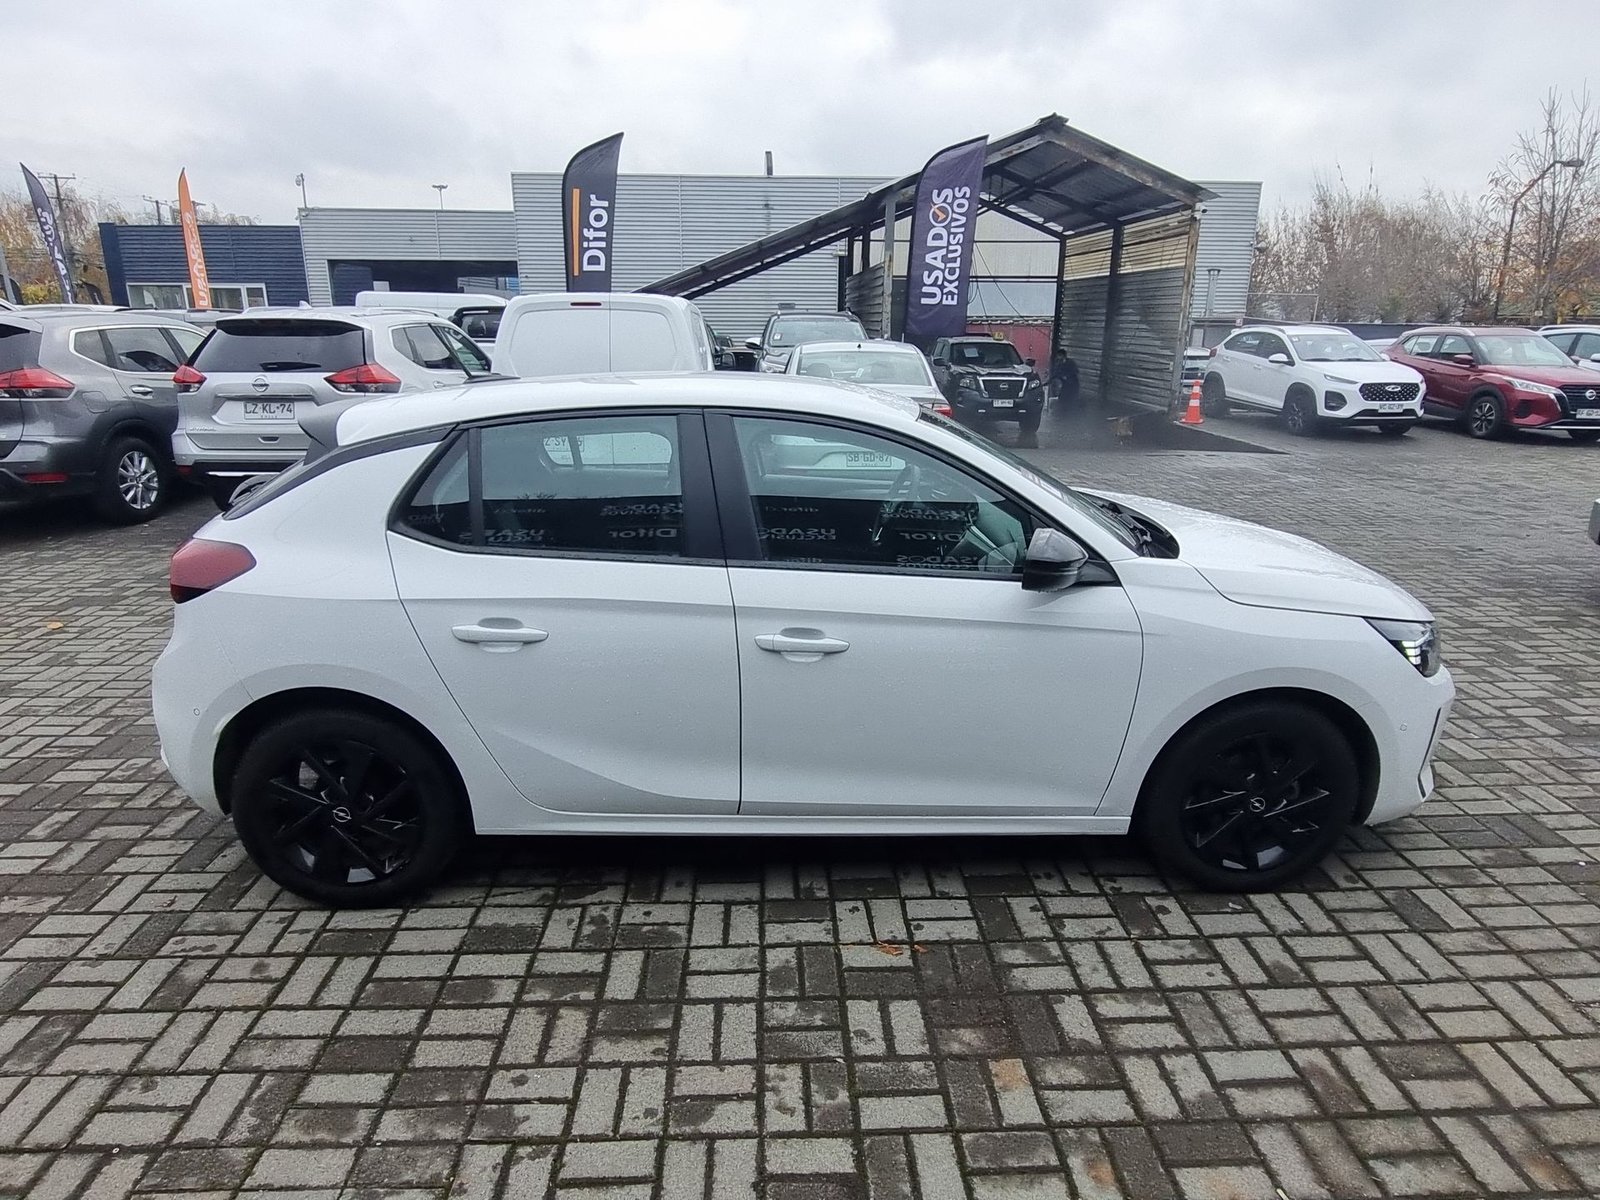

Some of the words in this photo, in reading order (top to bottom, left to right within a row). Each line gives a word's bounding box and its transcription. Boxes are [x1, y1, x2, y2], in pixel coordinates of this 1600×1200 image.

[583, 194, 609, 271] Difor
[921, 188, 954, 305] USADOS
[942, 186, 971, 305] EXCLUSIVOS
